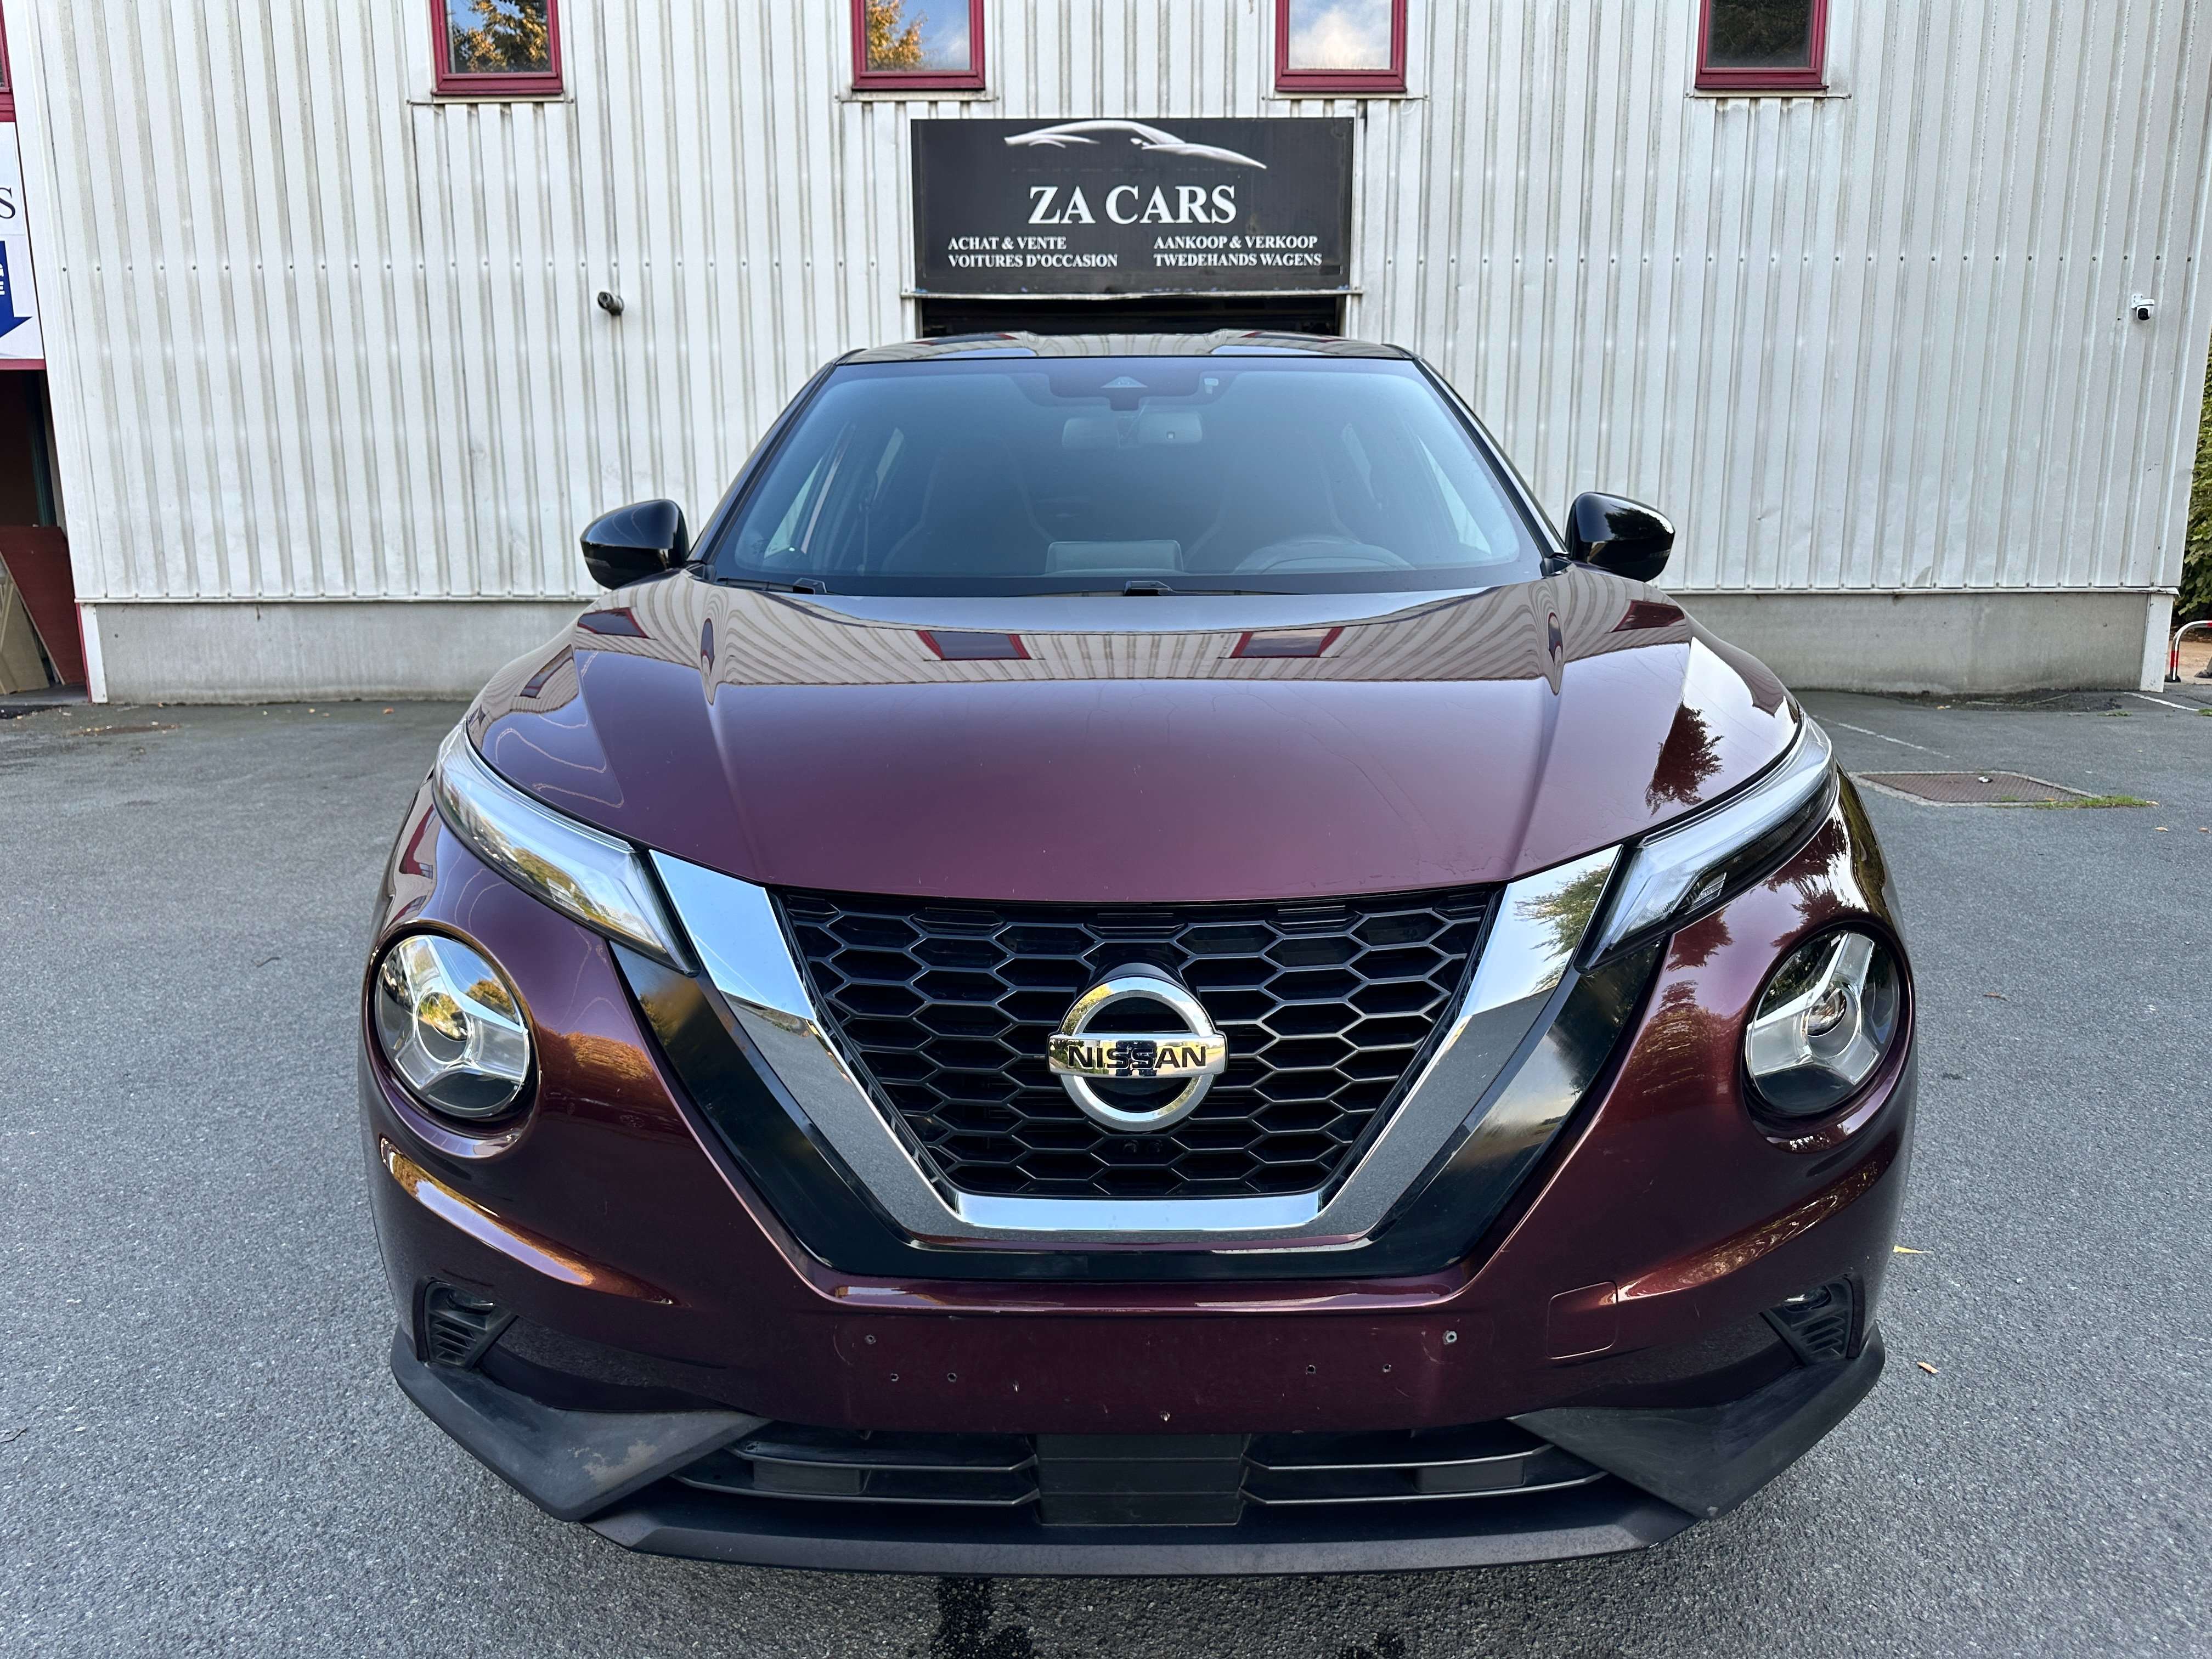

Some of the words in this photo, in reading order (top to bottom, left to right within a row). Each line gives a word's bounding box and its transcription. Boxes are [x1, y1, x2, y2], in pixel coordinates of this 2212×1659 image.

[1028, 184, 1096, 224] ZA
[1105, 184, 1237, 224] CARS
[947, 236, 999, 250] ACHAT
[1001, 236, 1014, 250] &
[1016, 236, 1067, 250] VENTE
[1153, 235, 1227, 249] AANKOOP
[1229, 235, 1242, 249] &
[1244, 235, 1318, 249] VERKOOP
[947, 254, 1023, 268] VOITURES
[1026, 253, 1118, 268] D'OCCASION
[1153, 253, 1257, 267] TWEDEHANDS
[1259, 253, 1323, 267] WAGENS
[1068, 1046, 1206, 1069] NISSAN
